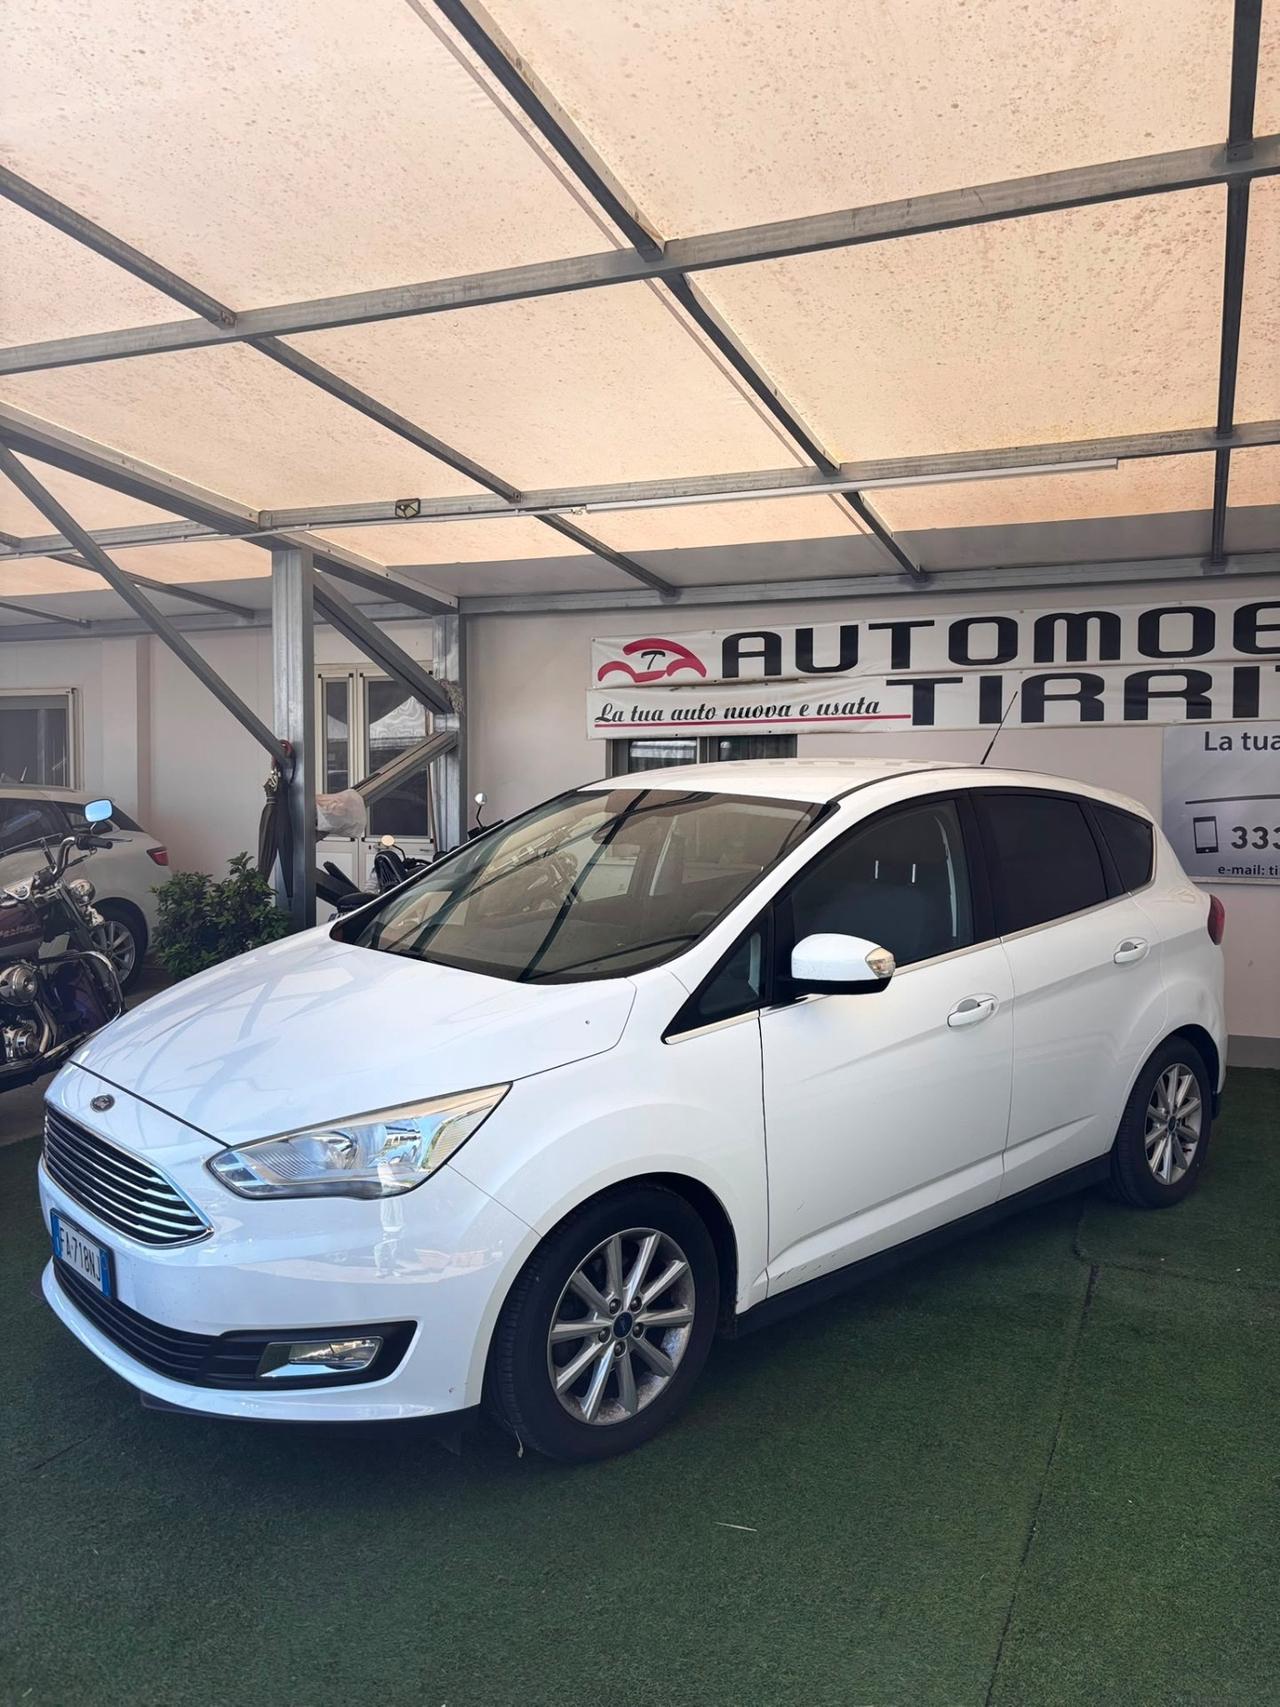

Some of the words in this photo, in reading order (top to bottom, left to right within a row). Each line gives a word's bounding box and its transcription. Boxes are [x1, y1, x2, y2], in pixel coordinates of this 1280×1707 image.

[886, 665, 1280, 726] TIRRI
[594, 703, 624, 723] La
[630, 705, 664, 722] tua
[671, 703, 716, 721] auto
[723, 704, 791, 719] nuova
[799, 703, 809, 717] e
[816, 697, 881, 716] usata
[1204, 731, 1233, 751] La
[1240, 732, 1280, 751] tua
[1217, 864, 1265, 876] e-mail:
